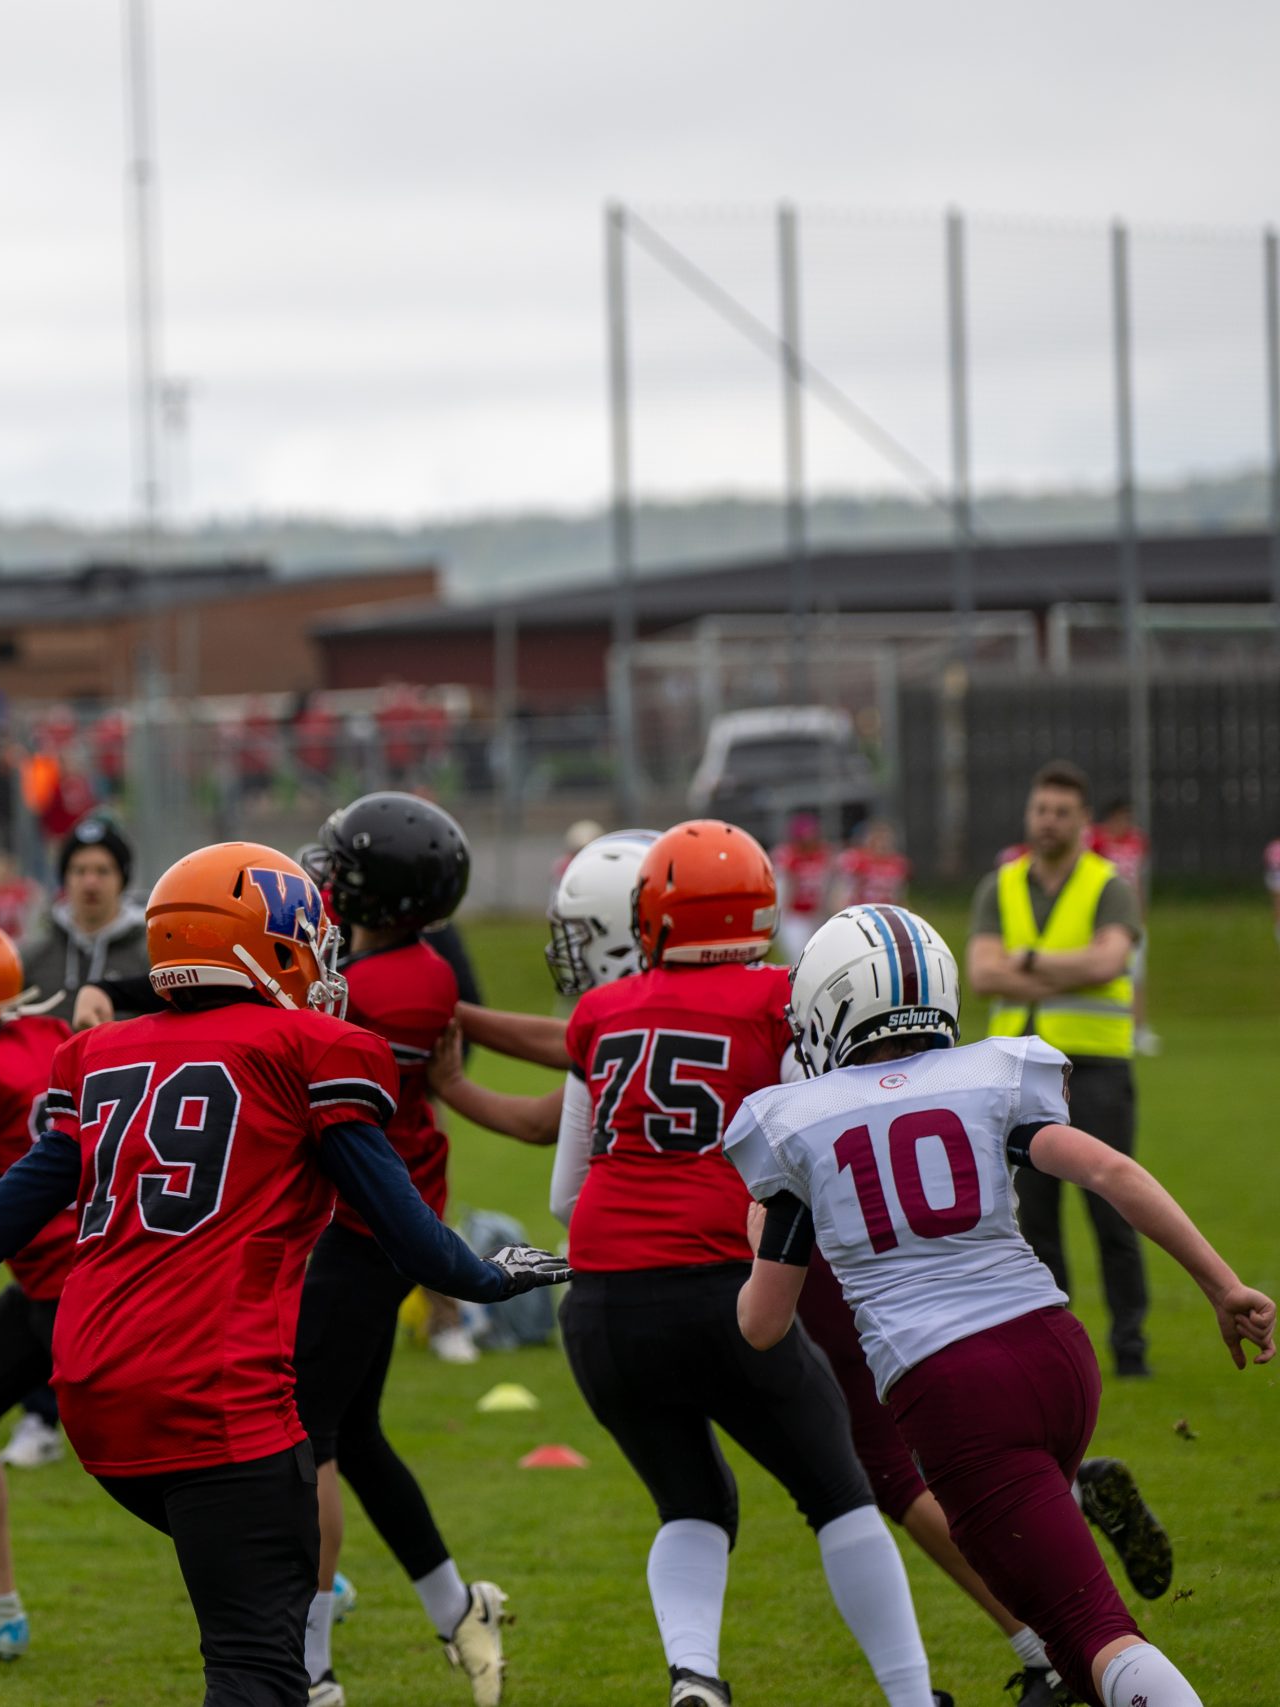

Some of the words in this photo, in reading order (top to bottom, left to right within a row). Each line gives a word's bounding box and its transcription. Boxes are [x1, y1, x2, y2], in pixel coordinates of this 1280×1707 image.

[247, 867, 323, 945] W
[150, 969, 200, 989] Riddell
[888, 1008, 940, 1027] schutt
[590, 1028, 731, 1155] 75
[76, 1061, 242, 1244] 79
[833, 1108, 982, 1255] 10
